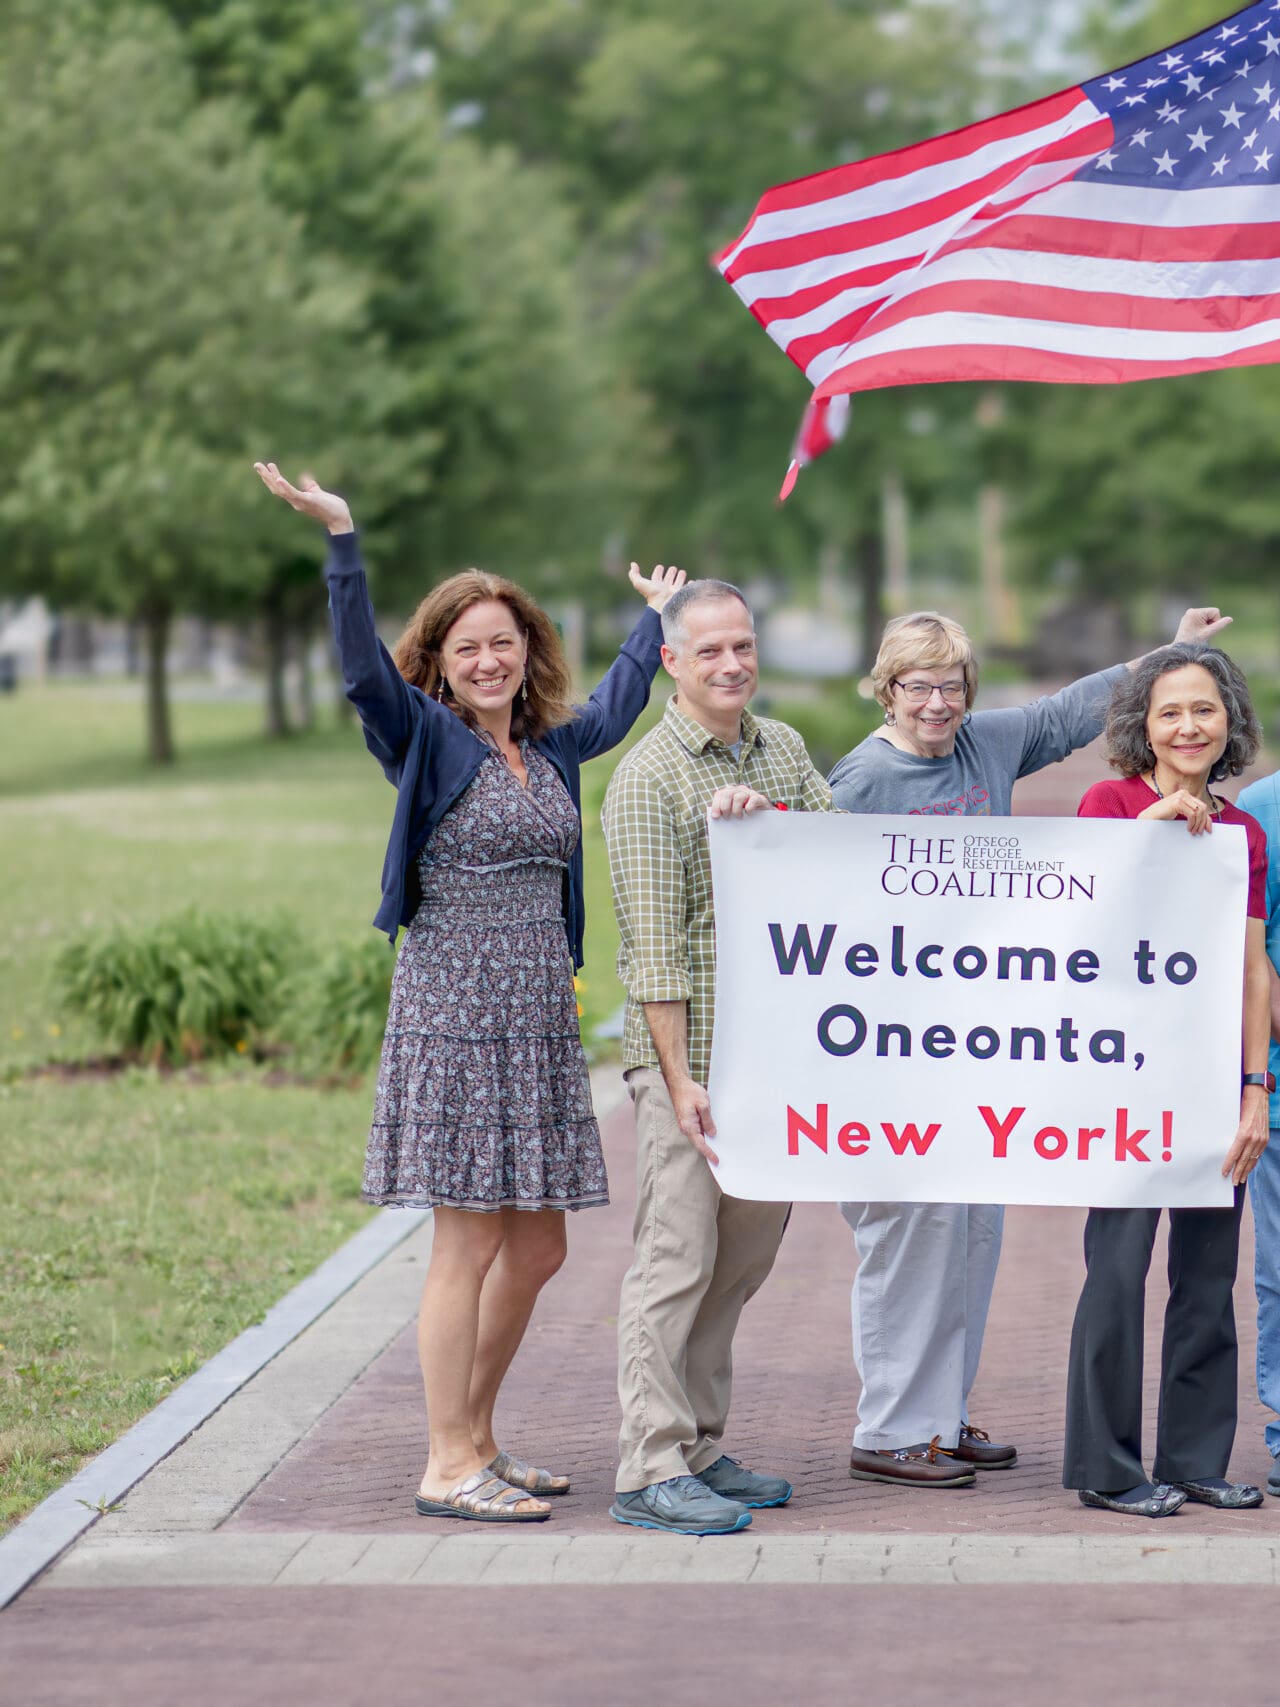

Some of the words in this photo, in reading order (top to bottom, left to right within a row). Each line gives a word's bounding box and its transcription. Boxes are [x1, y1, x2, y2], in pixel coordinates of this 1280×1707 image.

[882, 834, 955, 865] THE
[963, 835, 1019, 847] OTSEGO
[963, 847, 1022, 859] REFUGEE
[963, 858, 1065, 872] RESETTLEMENT
[881, 865, 1096, 901] COALITION
[768, 923, 1100, 983] Welcome
[1134, 940, 1198, 985] to
[817, 1004, 1145, 1071] Oneonta,
[787, 1104, 942, 1156] New
[977, 1106, 1174, 1162] York!
